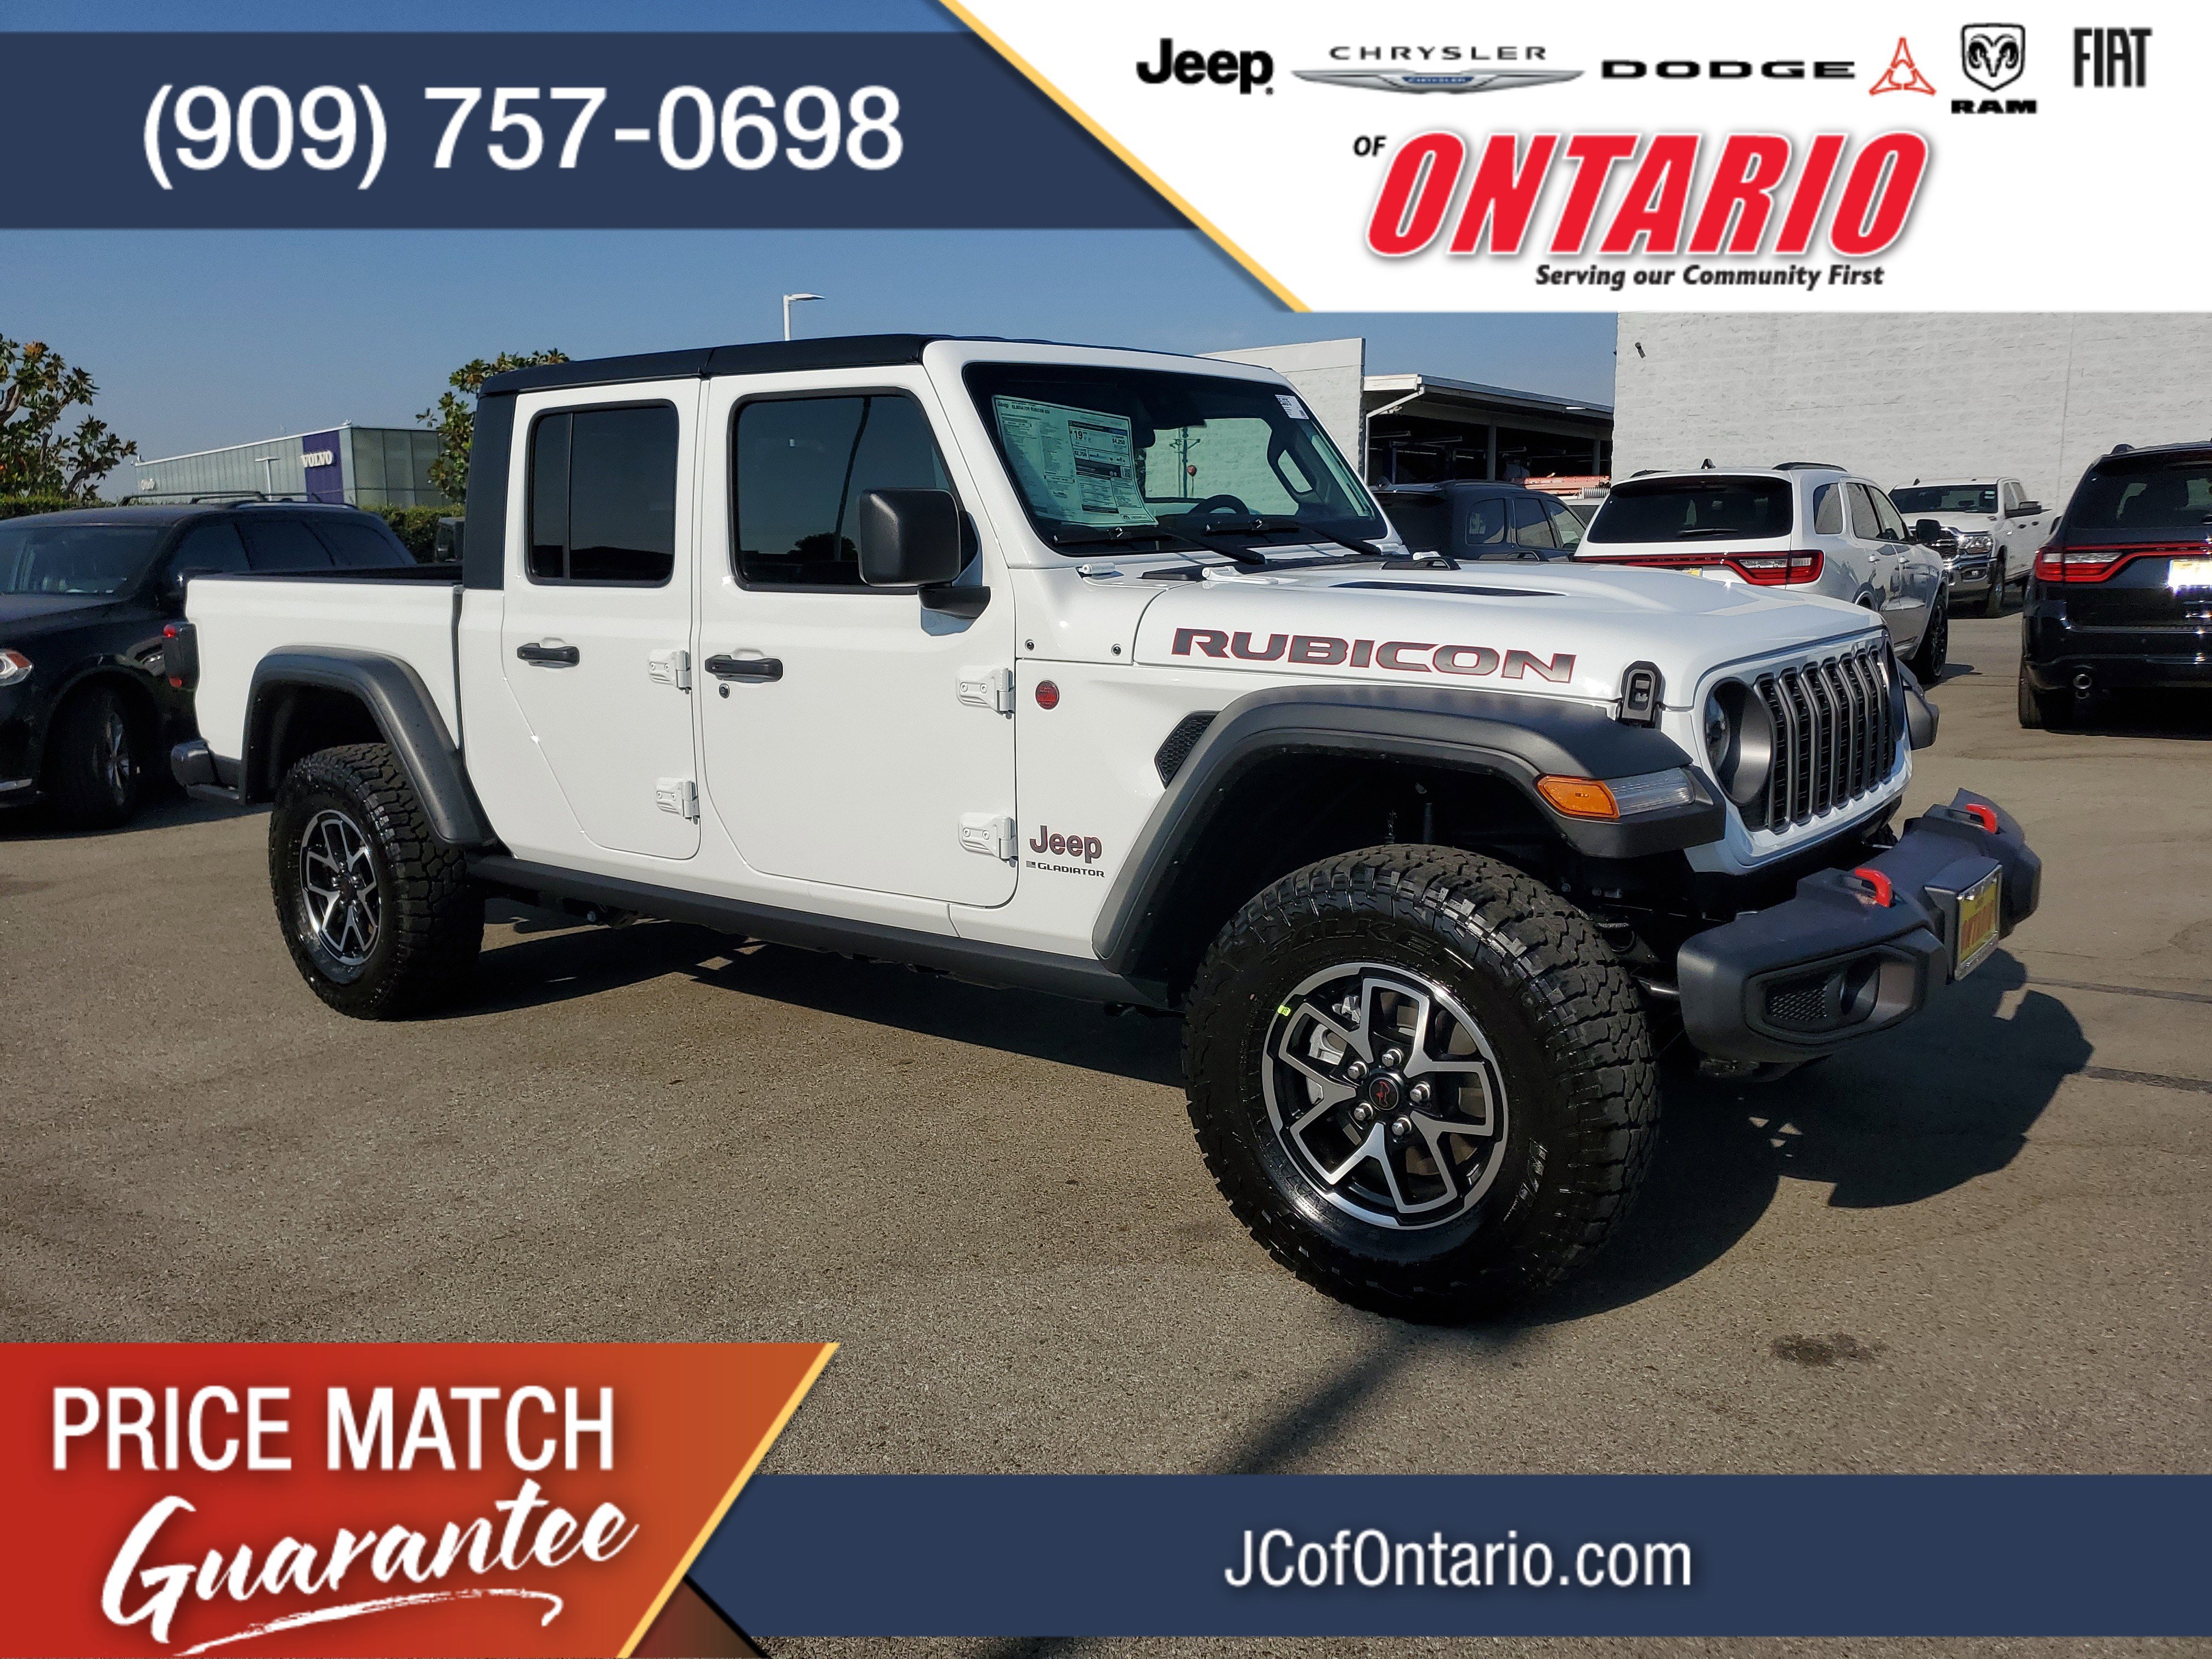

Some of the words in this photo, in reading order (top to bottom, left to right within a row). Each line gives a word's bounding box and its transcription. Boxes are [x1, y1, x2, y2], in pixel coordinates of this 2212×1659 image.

[300, 450, 332, 468] VOLVO
[1171, 627, 1577, 684] RUBICON
[1029, 825, 1102, 865] Jeep
[1037, 862, 1105, 878] GLADIATOR
